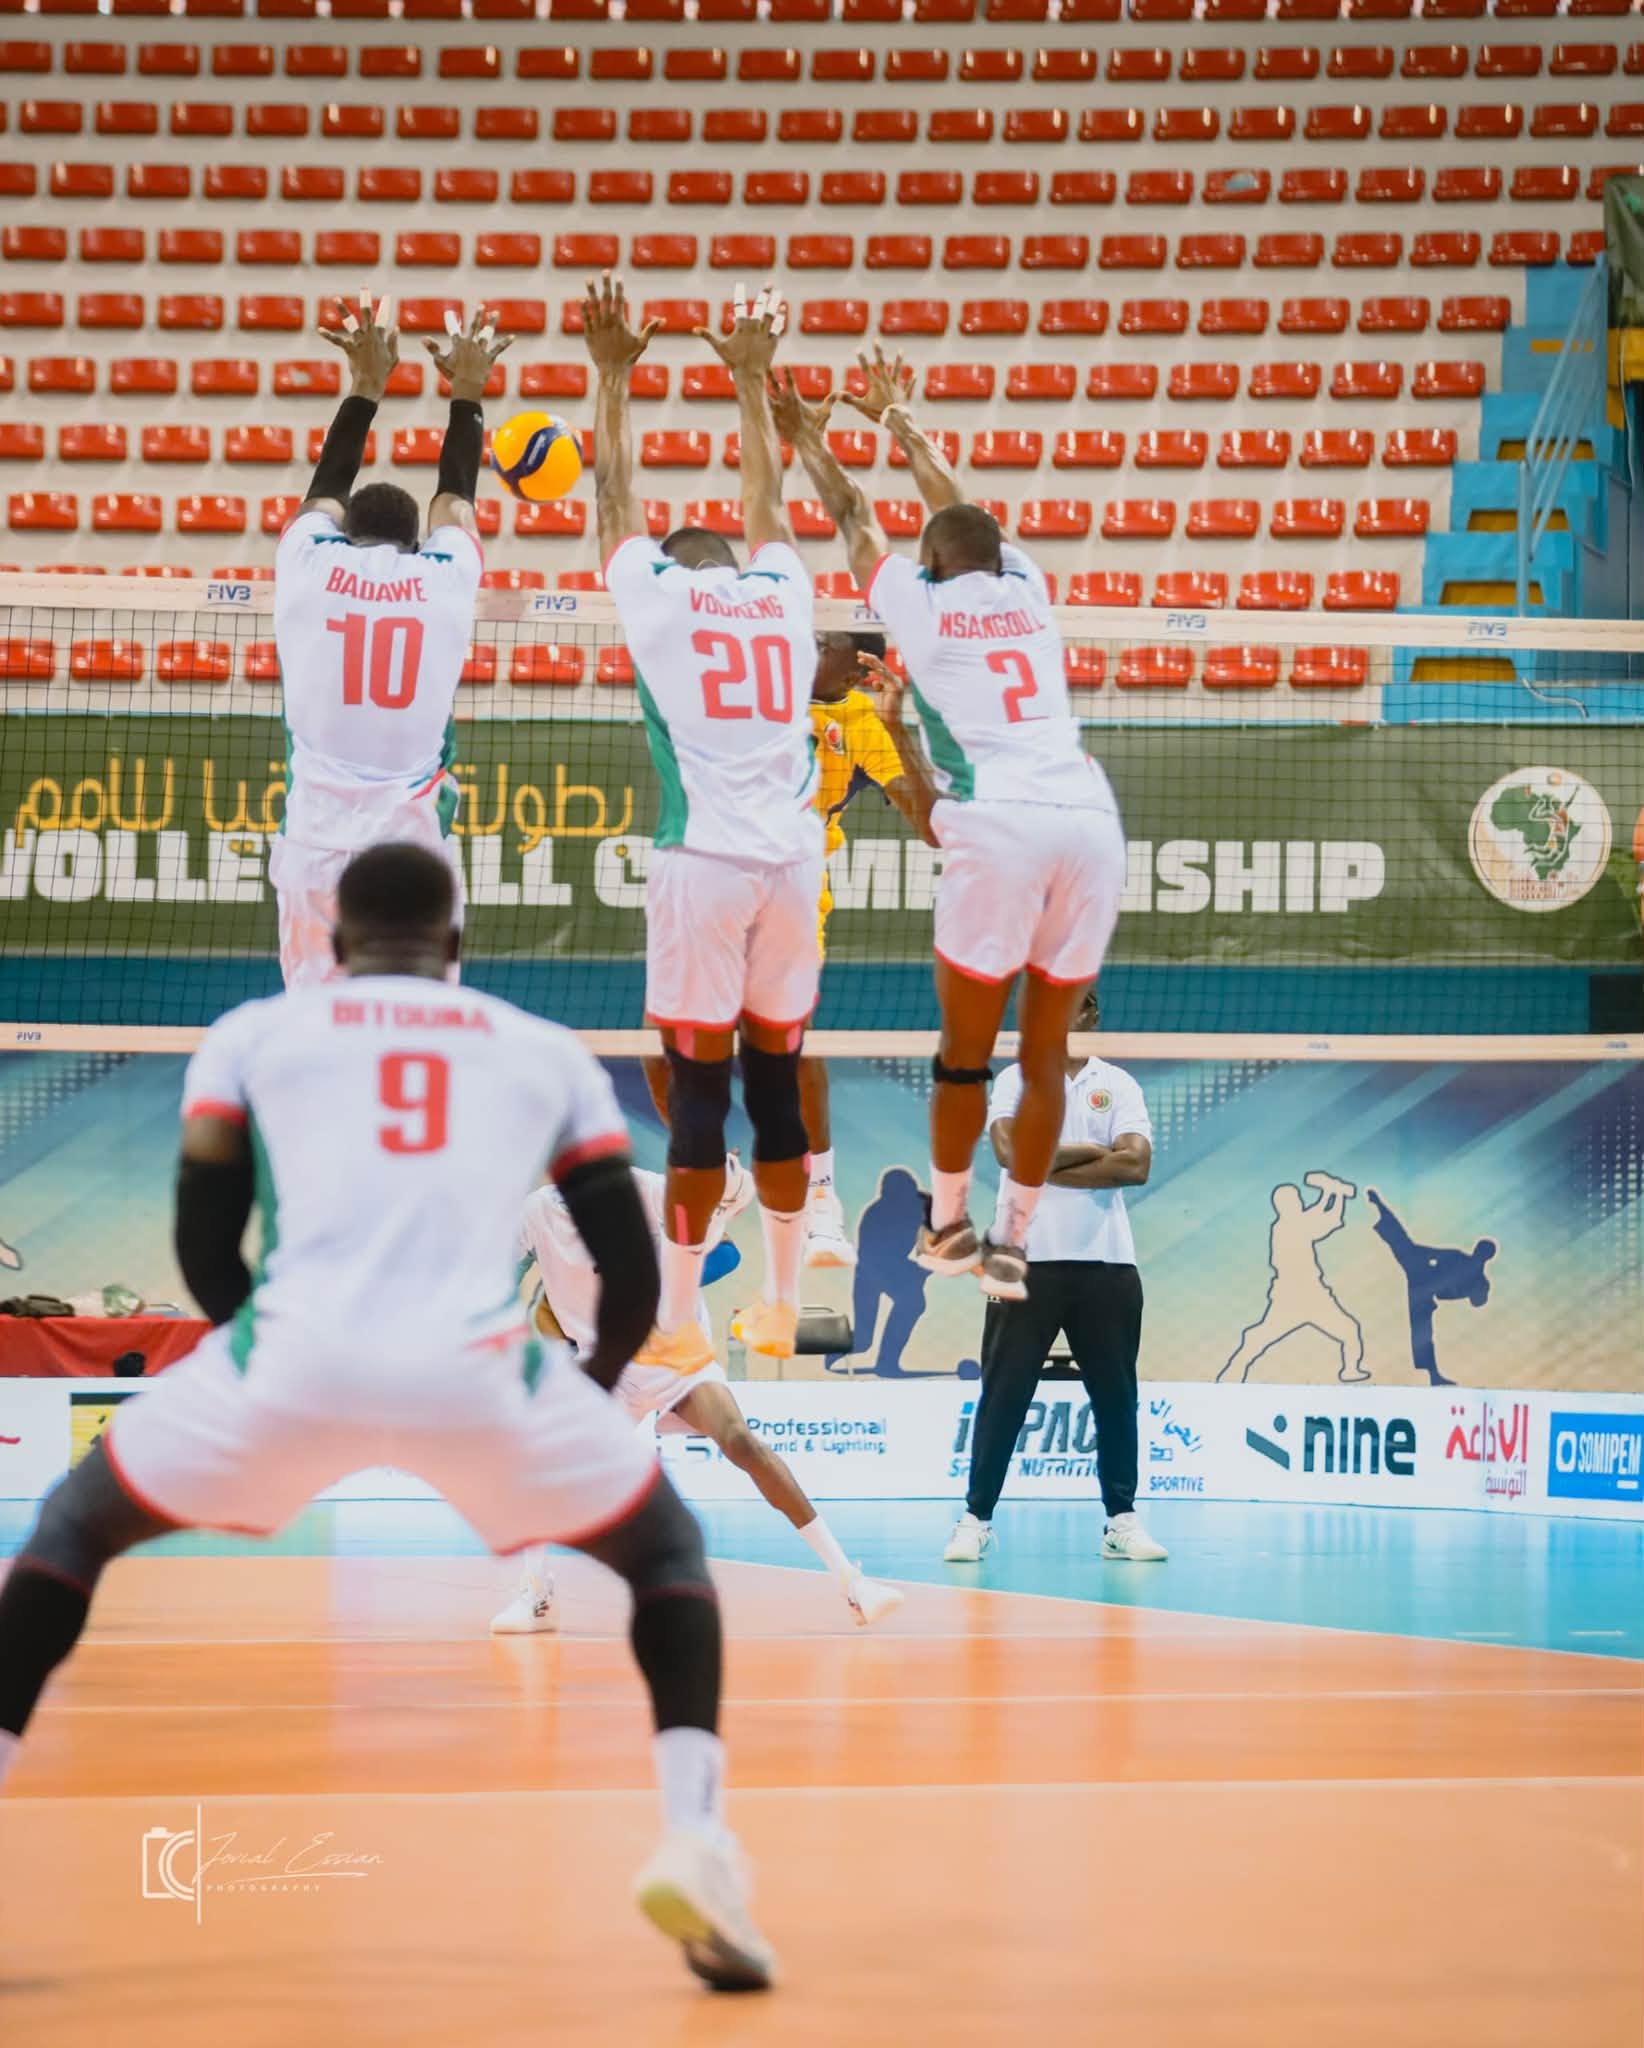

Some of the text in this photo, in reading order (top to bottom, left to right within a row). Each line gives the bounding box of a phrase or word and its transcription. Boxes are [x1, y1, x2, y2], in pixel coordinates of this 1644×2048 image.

[207, 584, 252, 601] FIVB
[326, 566, 428, 602] BADAWE
[535, 595, 577, 611] FIVB
[326, 612, 424, 710] 10
[691, 629, 793, 725] 20
[985, 649, 1050, 723] 2
[378, 1050, 452, 1155] 9
[746, 1417, 887, 1436] Professional
[1578, 1431, 1641, 1476] SOMIPEM
[1150, 1475, 1205, 1492] SPORTIVE
